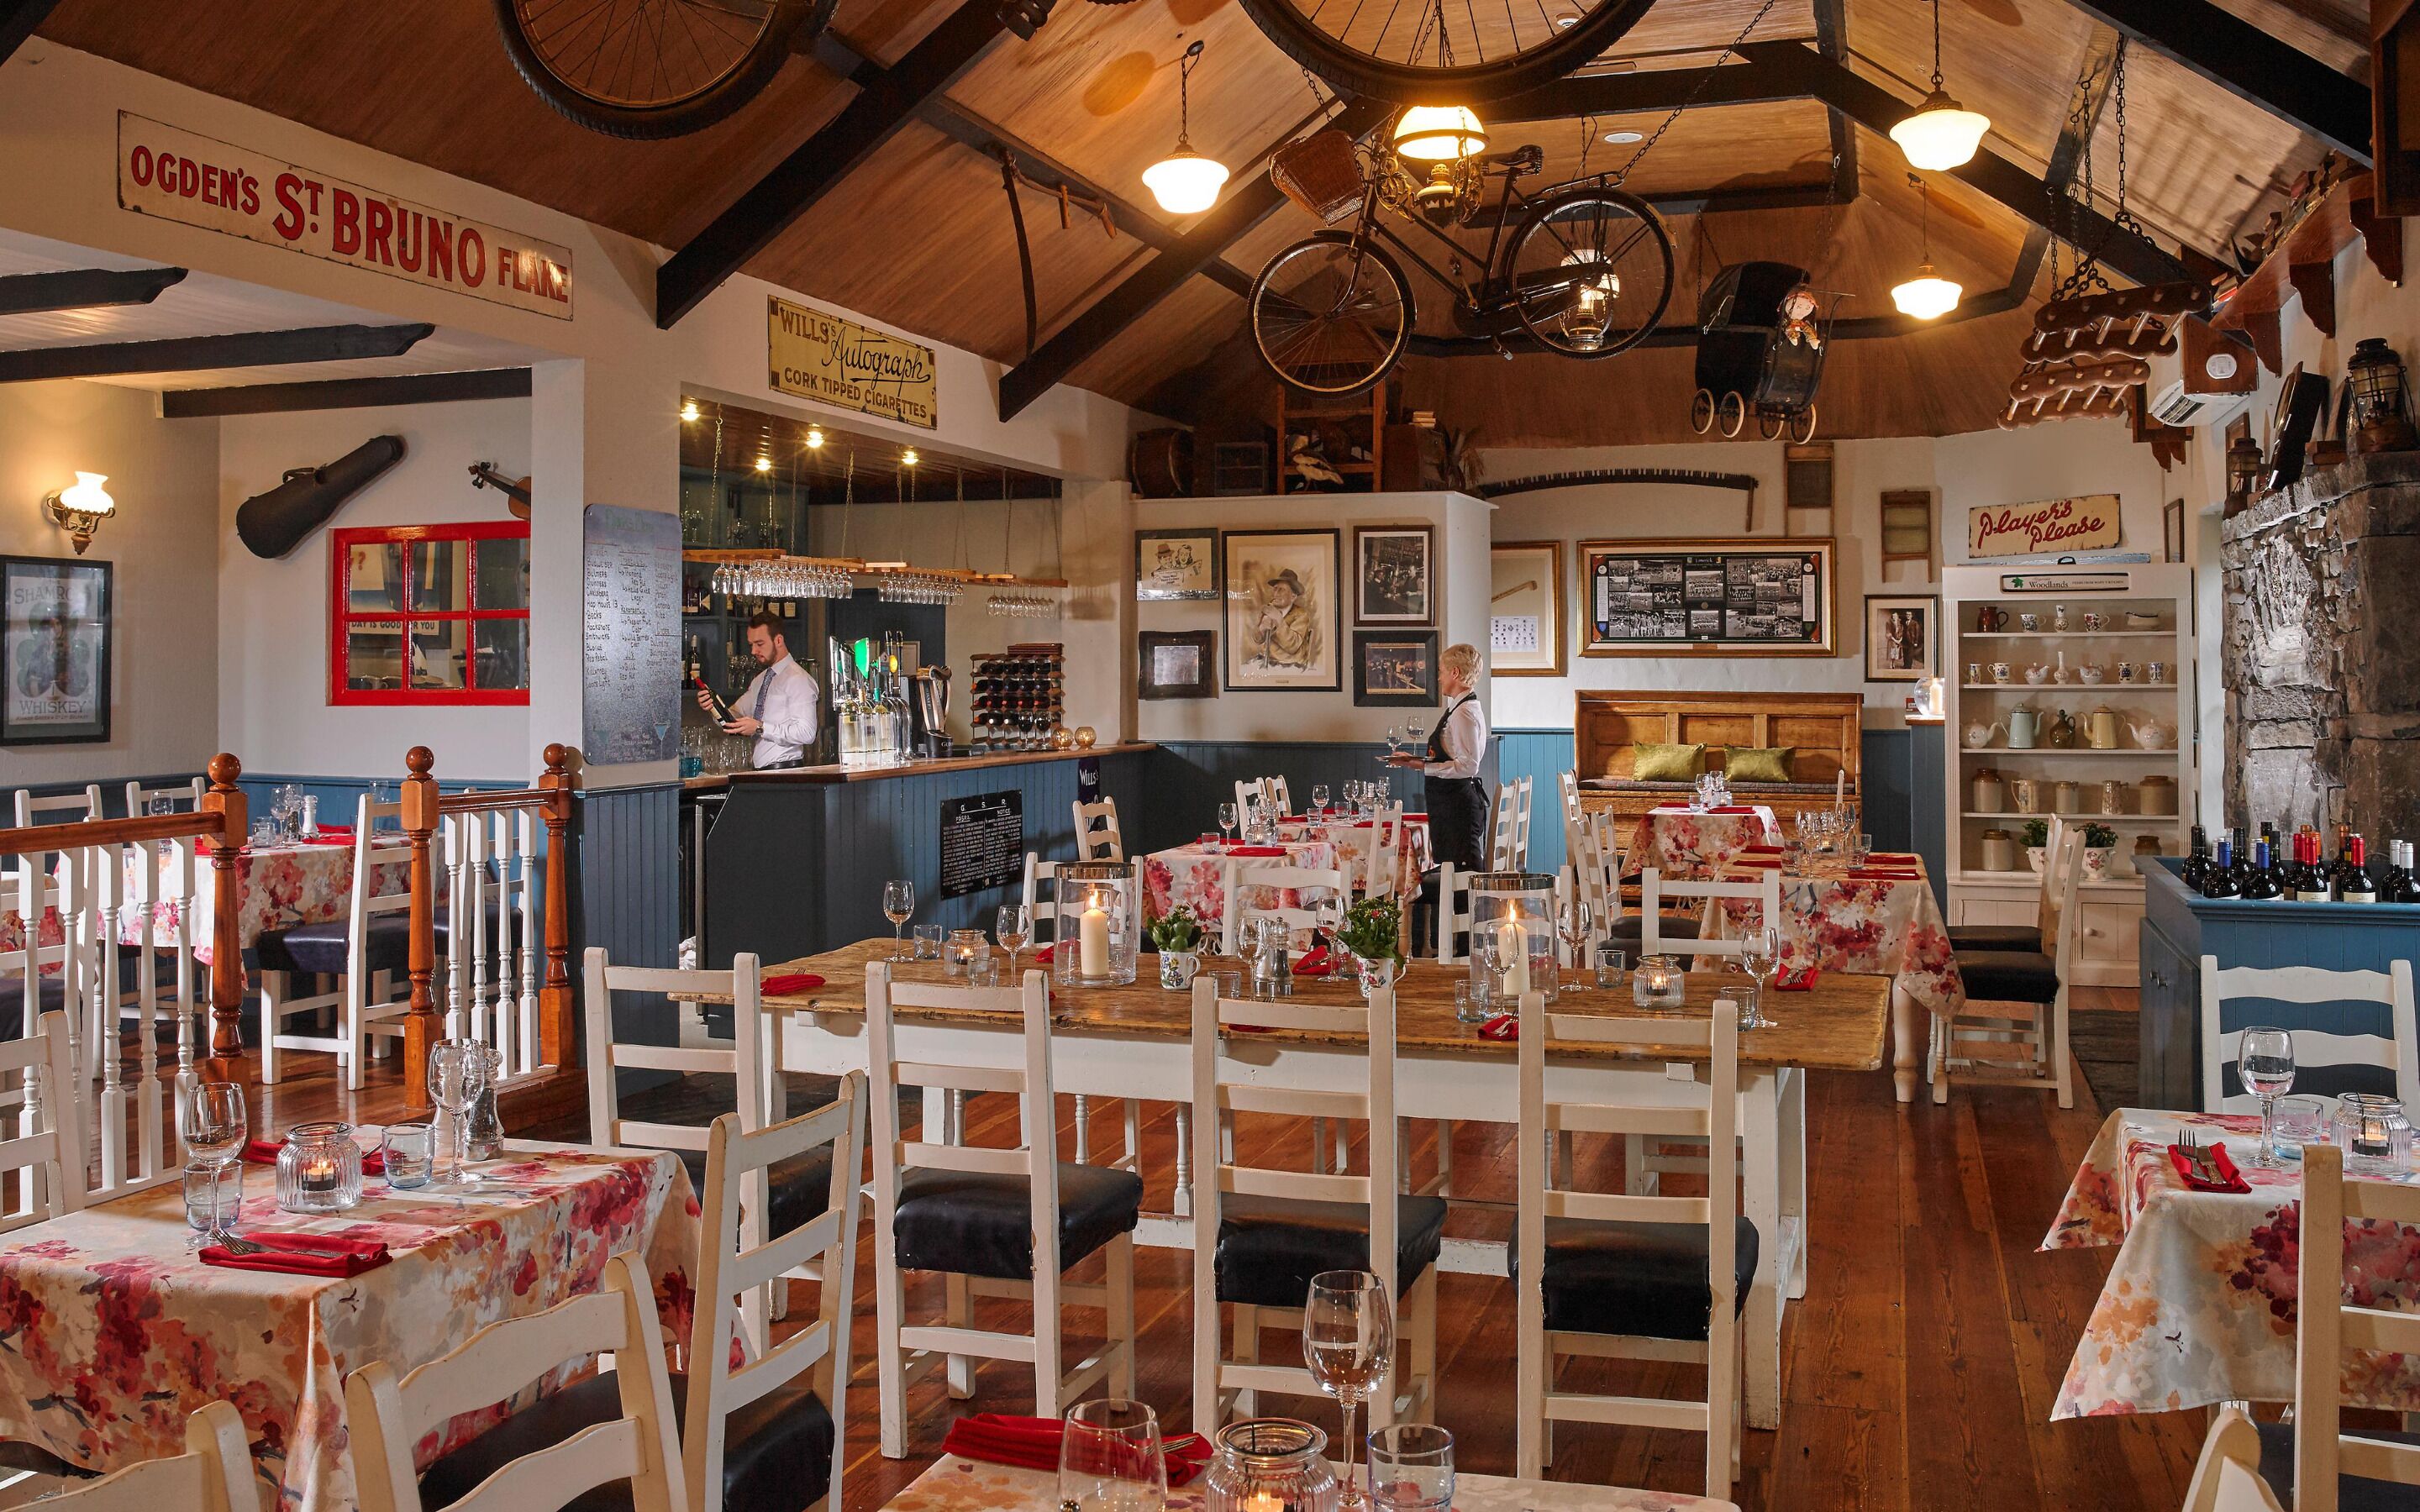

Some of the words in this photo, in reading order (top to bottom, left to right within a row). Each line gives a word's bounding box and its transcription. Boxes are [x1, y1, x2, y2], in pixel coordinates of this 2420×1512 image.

[130, 144, 260, 216] OGDEN'S
[331, 187, 486, 288] BRUNO
[497, 246, 569, 303] FLAKE
[821, 324, 931, 397] Autograph
[784, 367, 818, 391] CORK
[821, 377, 861, 401] TIPPED
[864, 389, 928, 419] CIGARETTES
[2028, 580, 2069, 589] Woodlands
[14, 585, 82, 605] SHAMRO
[380, 621, 402, 629] GOOD
[421, 622, 435, 630] YOU
[19, 700, 87, 715] WHISKEY
